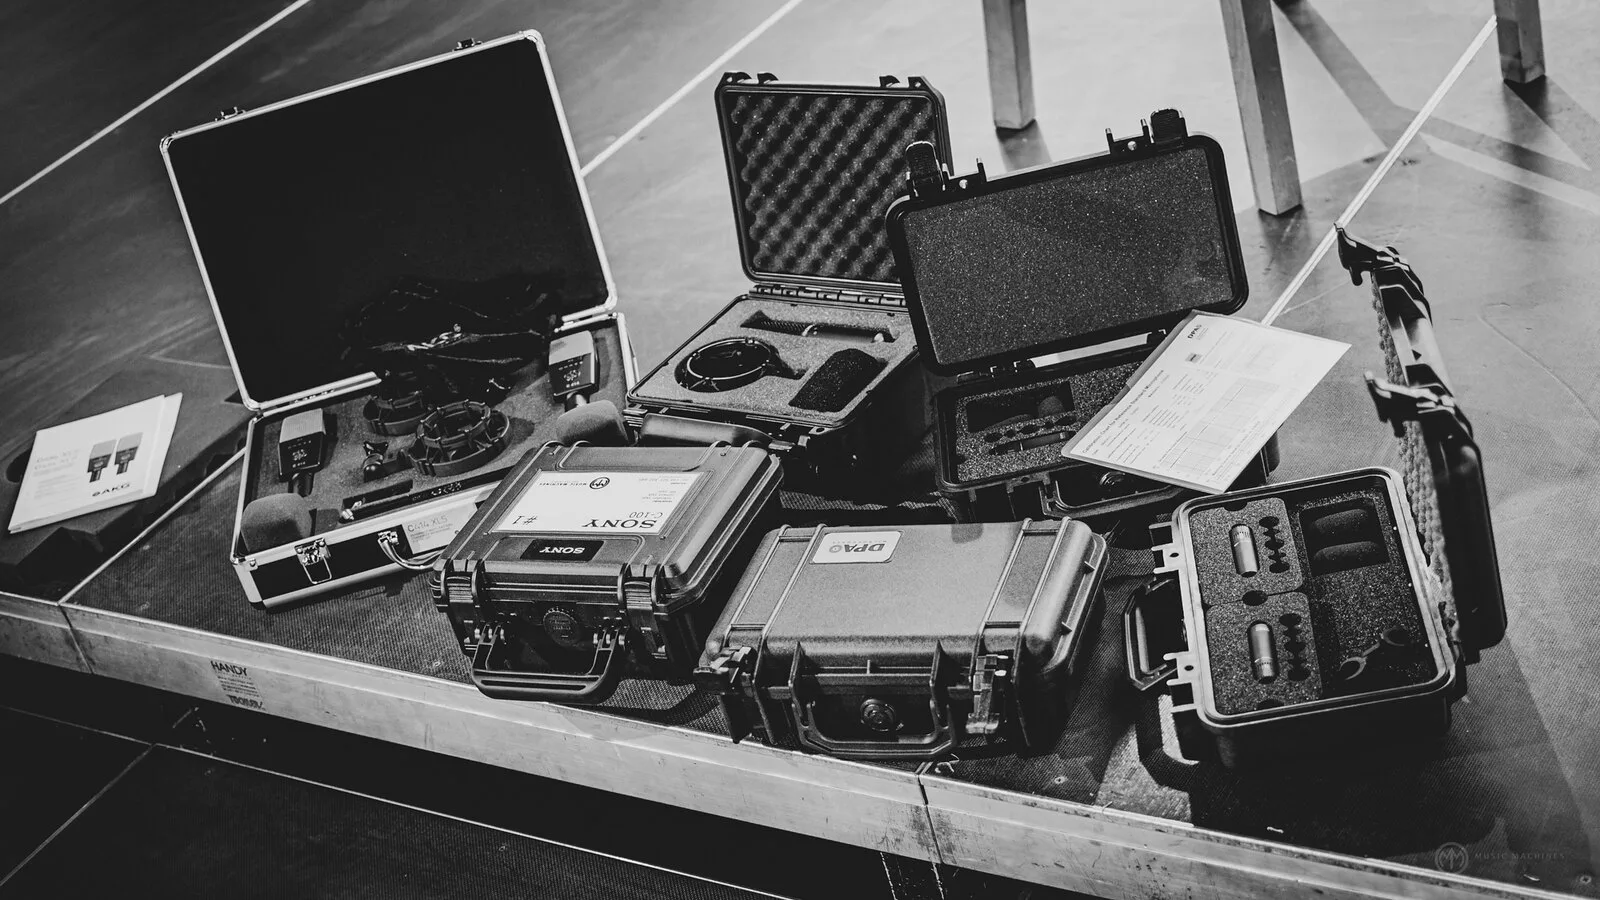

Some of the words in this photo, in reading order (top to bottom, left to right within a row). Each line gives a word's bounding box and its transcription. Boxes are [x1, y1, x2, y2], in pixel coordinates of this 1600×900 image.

[628, 511, 663, 519] C-100
[511, 515, 538, 525] #1
[581, 518, 658, 528] SONY
[539, 546, 585, 554] SONY
[844, 543, 885, 552] DPA
[210, 660, 247, 676] HANDY
